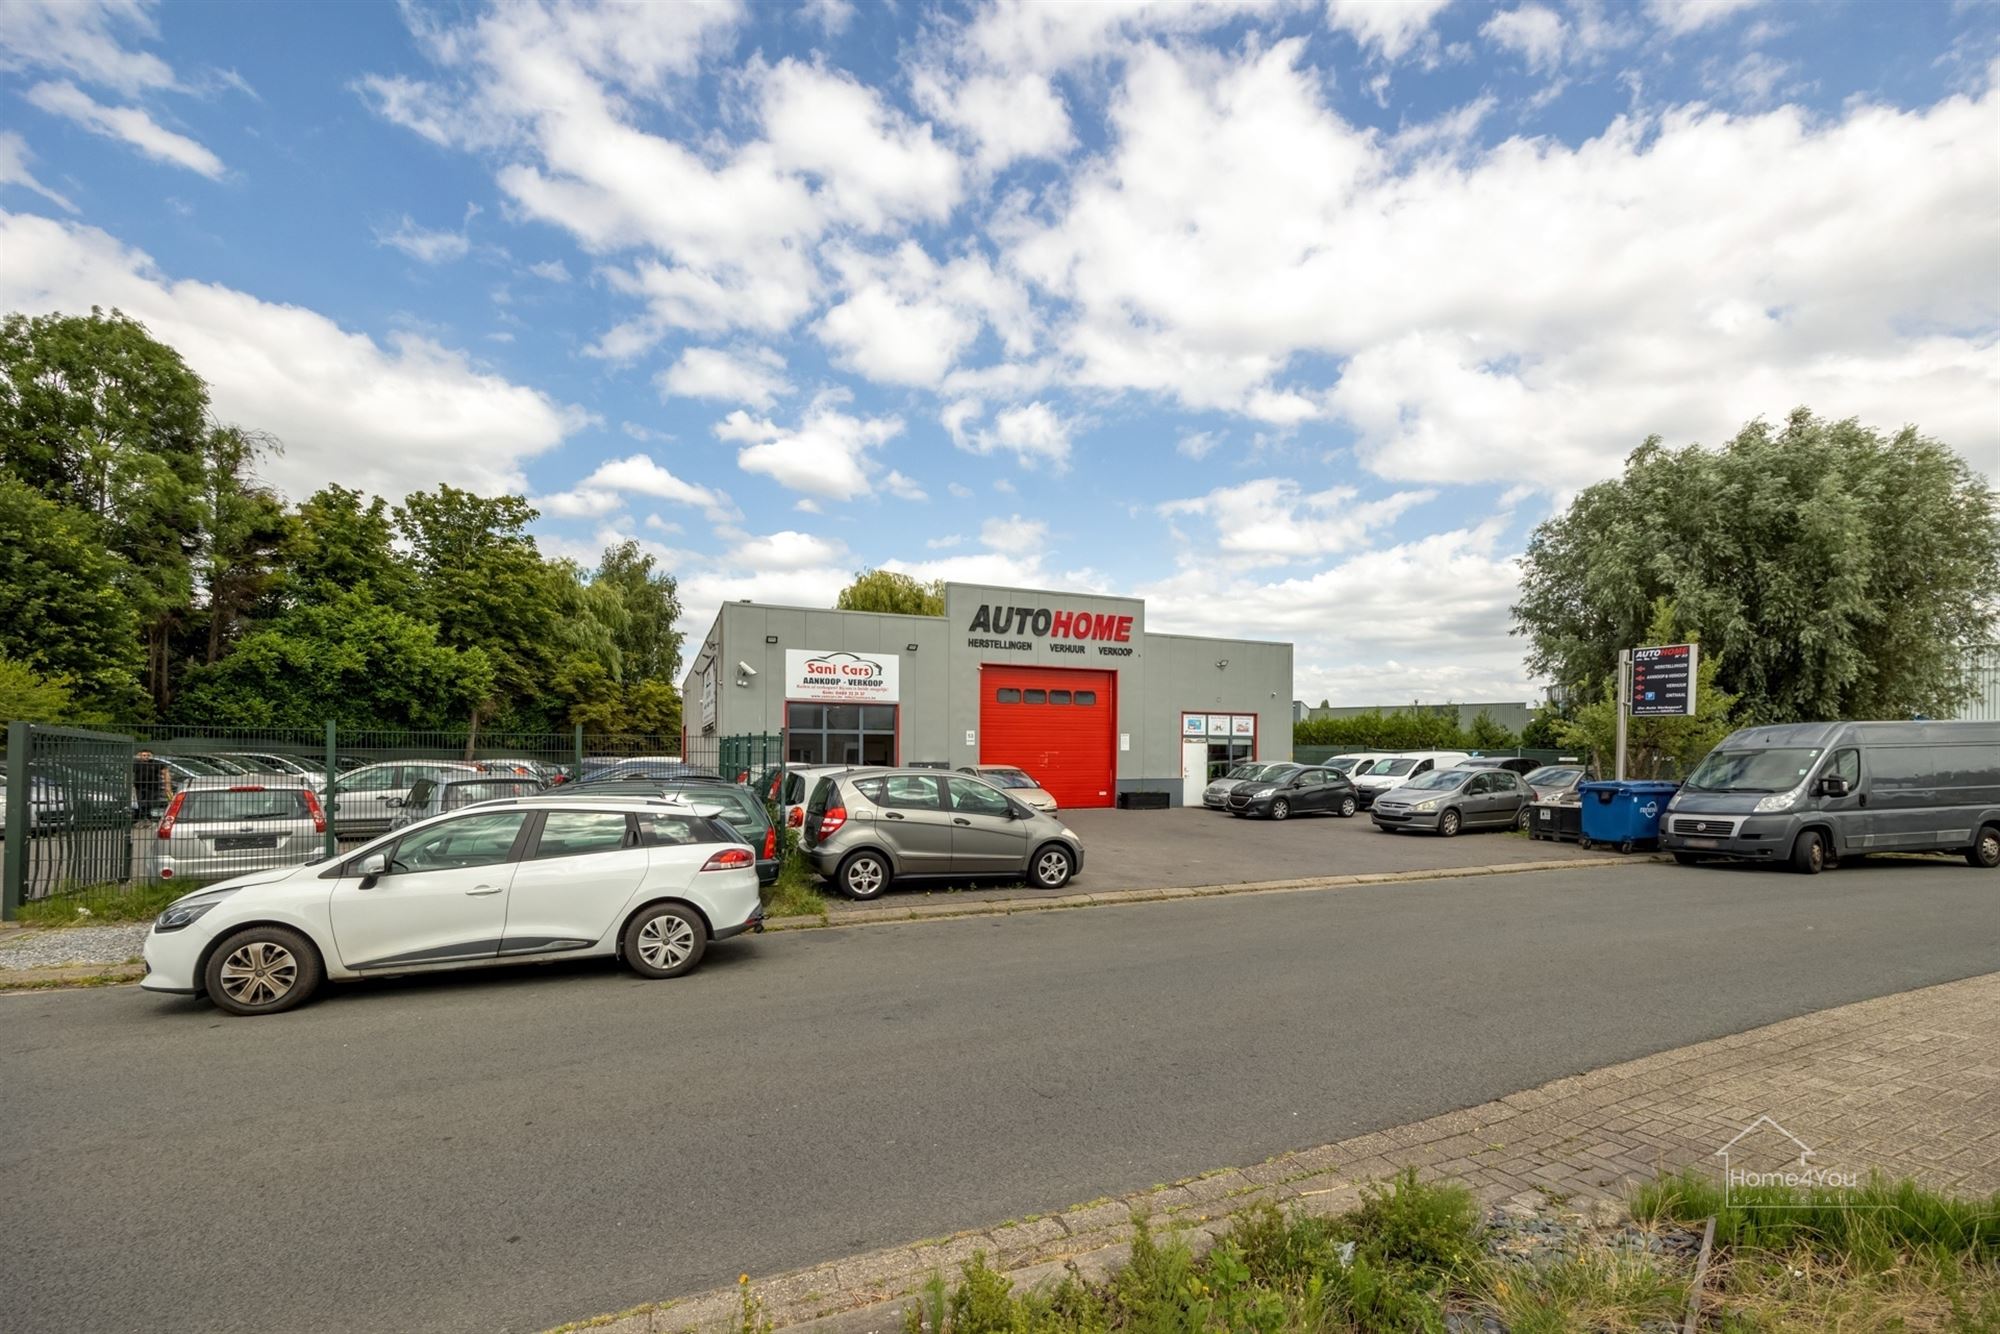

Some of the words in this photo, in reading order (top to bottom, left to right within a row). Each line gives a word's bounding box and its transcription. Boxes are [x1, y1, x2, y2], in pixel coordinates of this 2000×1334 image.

[968, 604, 1134, 642] AUTOHOME
[968, 638, 1032, 651] HERSTELLINGEN
[1050, 643, 1085, 654] VERHUUR
[1097, 646, 1133, 657] VERKOOP
[807, 663, 836, 674] Sani
[842, 665, 870, 676] Cars
[803, 677, 841, 685] AANKOOP
[847, 679, 883, 687] VERKOOP
